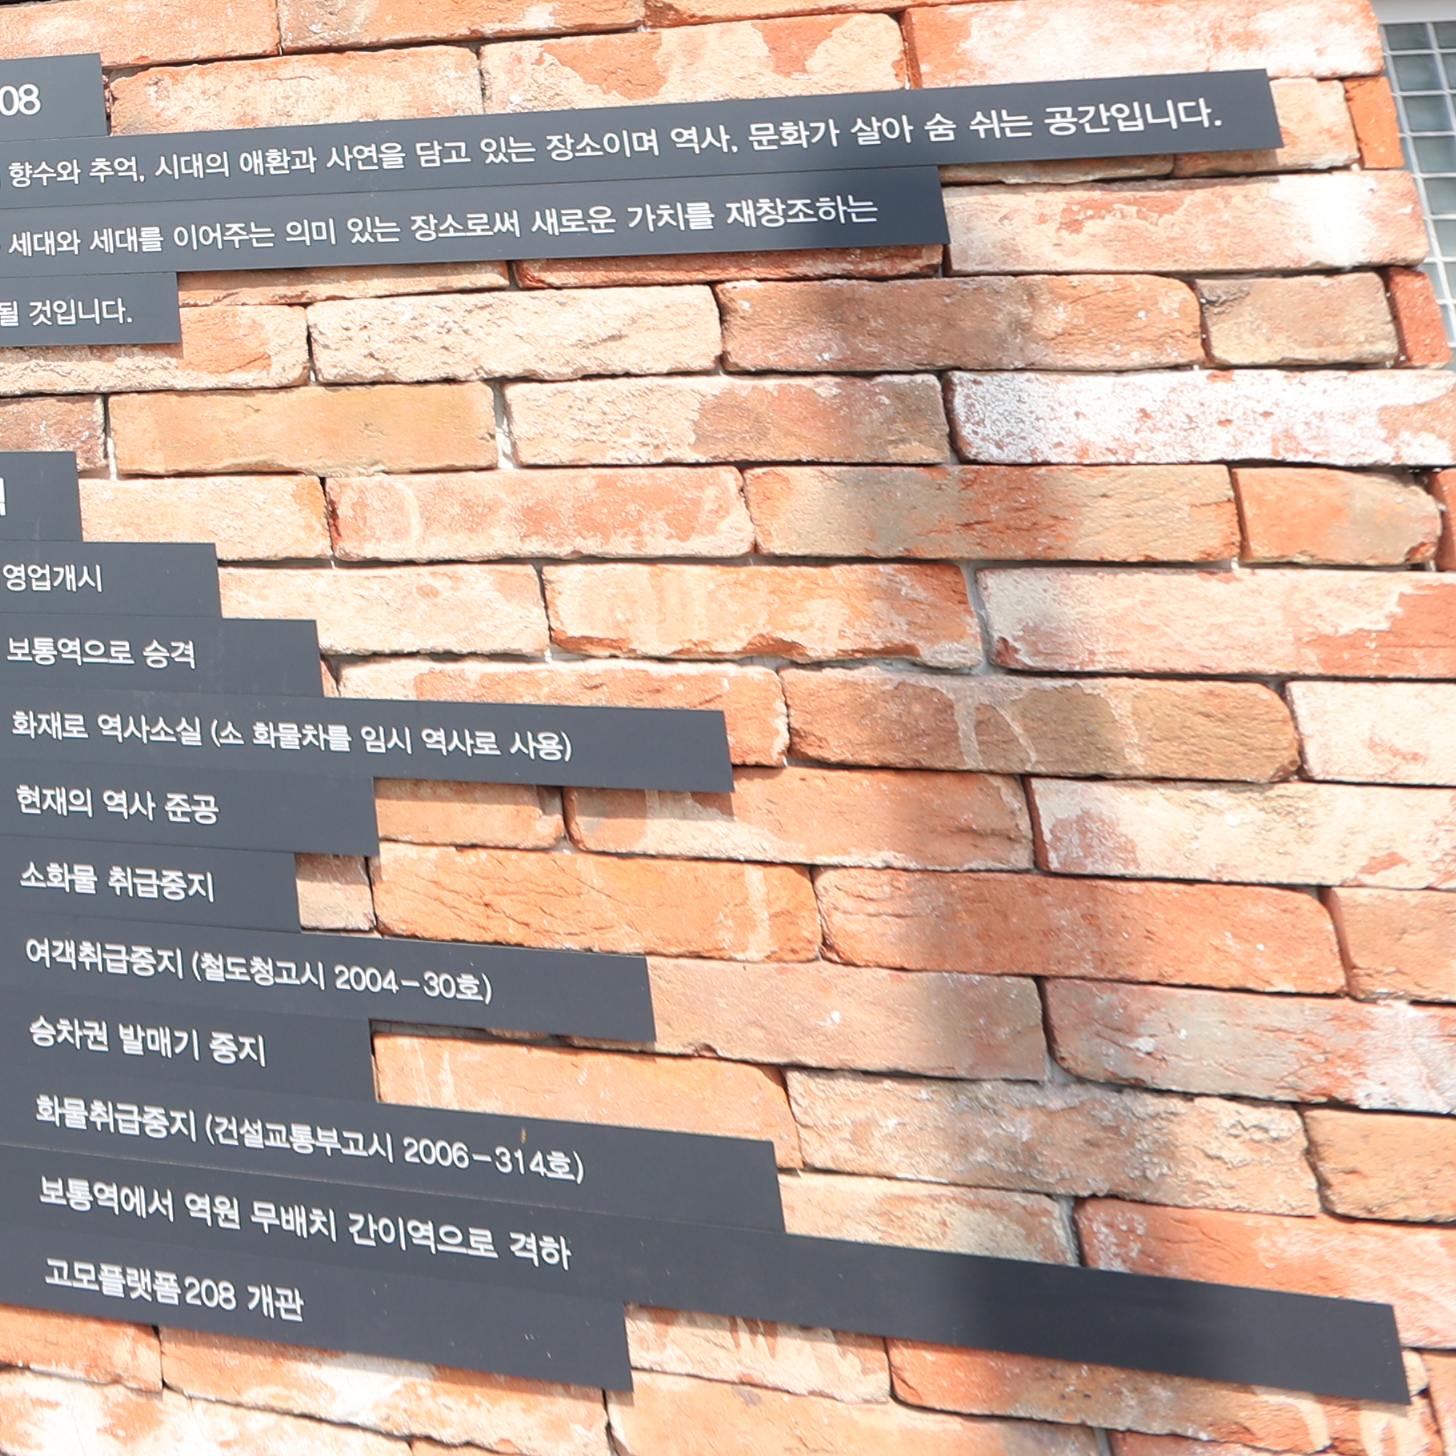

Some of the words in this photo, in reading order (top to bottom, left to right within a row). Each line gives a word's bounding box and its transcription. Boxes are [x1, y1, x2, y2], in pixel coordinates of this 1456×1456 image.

[8, 159, 82, 188] 향수와
[89, 156, 145, 183] 추억,
[155, 151, 229, 180] 시대의
[239, 146, 317, 176] 애환과
[326, 142, 406, 172] 사연을
[415, 140, 472, 168] 담고
[480, 136, 536, 164] 있는
[546, 128, 659, 161] 장소이며
[670, 124, 738, 154] 역사,
[748, 118, 840, 151] 문화가
[850, 114, 914, 145] 살아
[924, 112, 957, 142] 숨
[969, 109, 1033, 139] 쉬는
[1044, 97, 1222, 136] 공간입니다.
[8, 229, 81, 257] 세대와
[89, 226, 164, 254] 세대를
[173, 221, 275, 251] 이어주는
[285, 218, 336, 246] 의미
[347, 216, 401, 244] 있는
[410, 209, 521, 242] 장소로써
[531, 205, 617, 236] 새로운
[627, 202, 715, 232] 가치를
[725, 194, 878, 228] 재창조하는
[29, 297, 133, 326] 것입니다.
[2, 563, 102, 592] 영업개시
[6, 637, 135, 666] 보통역으로
[142, 639, 195, 670] 승격
[12, 710, 89, 740] 화재로
[97, 713, 203, 746] 역사소실
[252, 721, 352, 752] 화물차를
[360, 725, 412, 755] 임시
[421, 727, 502, 757] 역사로
[509, 731, 572, 762] 사용)
[16, 784, 93, 818] 현재의
[102, 789, 157, 821] 역사
[164, 793, 219, 825] 준공
[20, 861, 98, 894] 소화물
[108, 865, 214, 903] 취급중지
[26, 937, 183, 979] 여객취급중지
[192, 951, 325, 991] (철도청고시
[334, 964, 492, 1005] 2004-30호)
[29, 1015, 109, 1052] 승차권
[118, 1023, 199, 1061] 발매기
[209, 1031, 266, 1067] 중지
[36, 1094, 196, 1142] 화물취급중지
[205, 1113, 394, 1163] (건설교통부고시
[403, 1137, 584, 1184] 2006-314호)
[39, 1176, 174, 1222] 보통역에서
[184, 1193, 241, 1230] 역원
[250, 1201, 337, 1242] 무배치
[348, 1213, 499, 1259] 간이역으로
[509, 1232, 572, 1271] 격하
[247, 1284, 305, 1322] 개관
